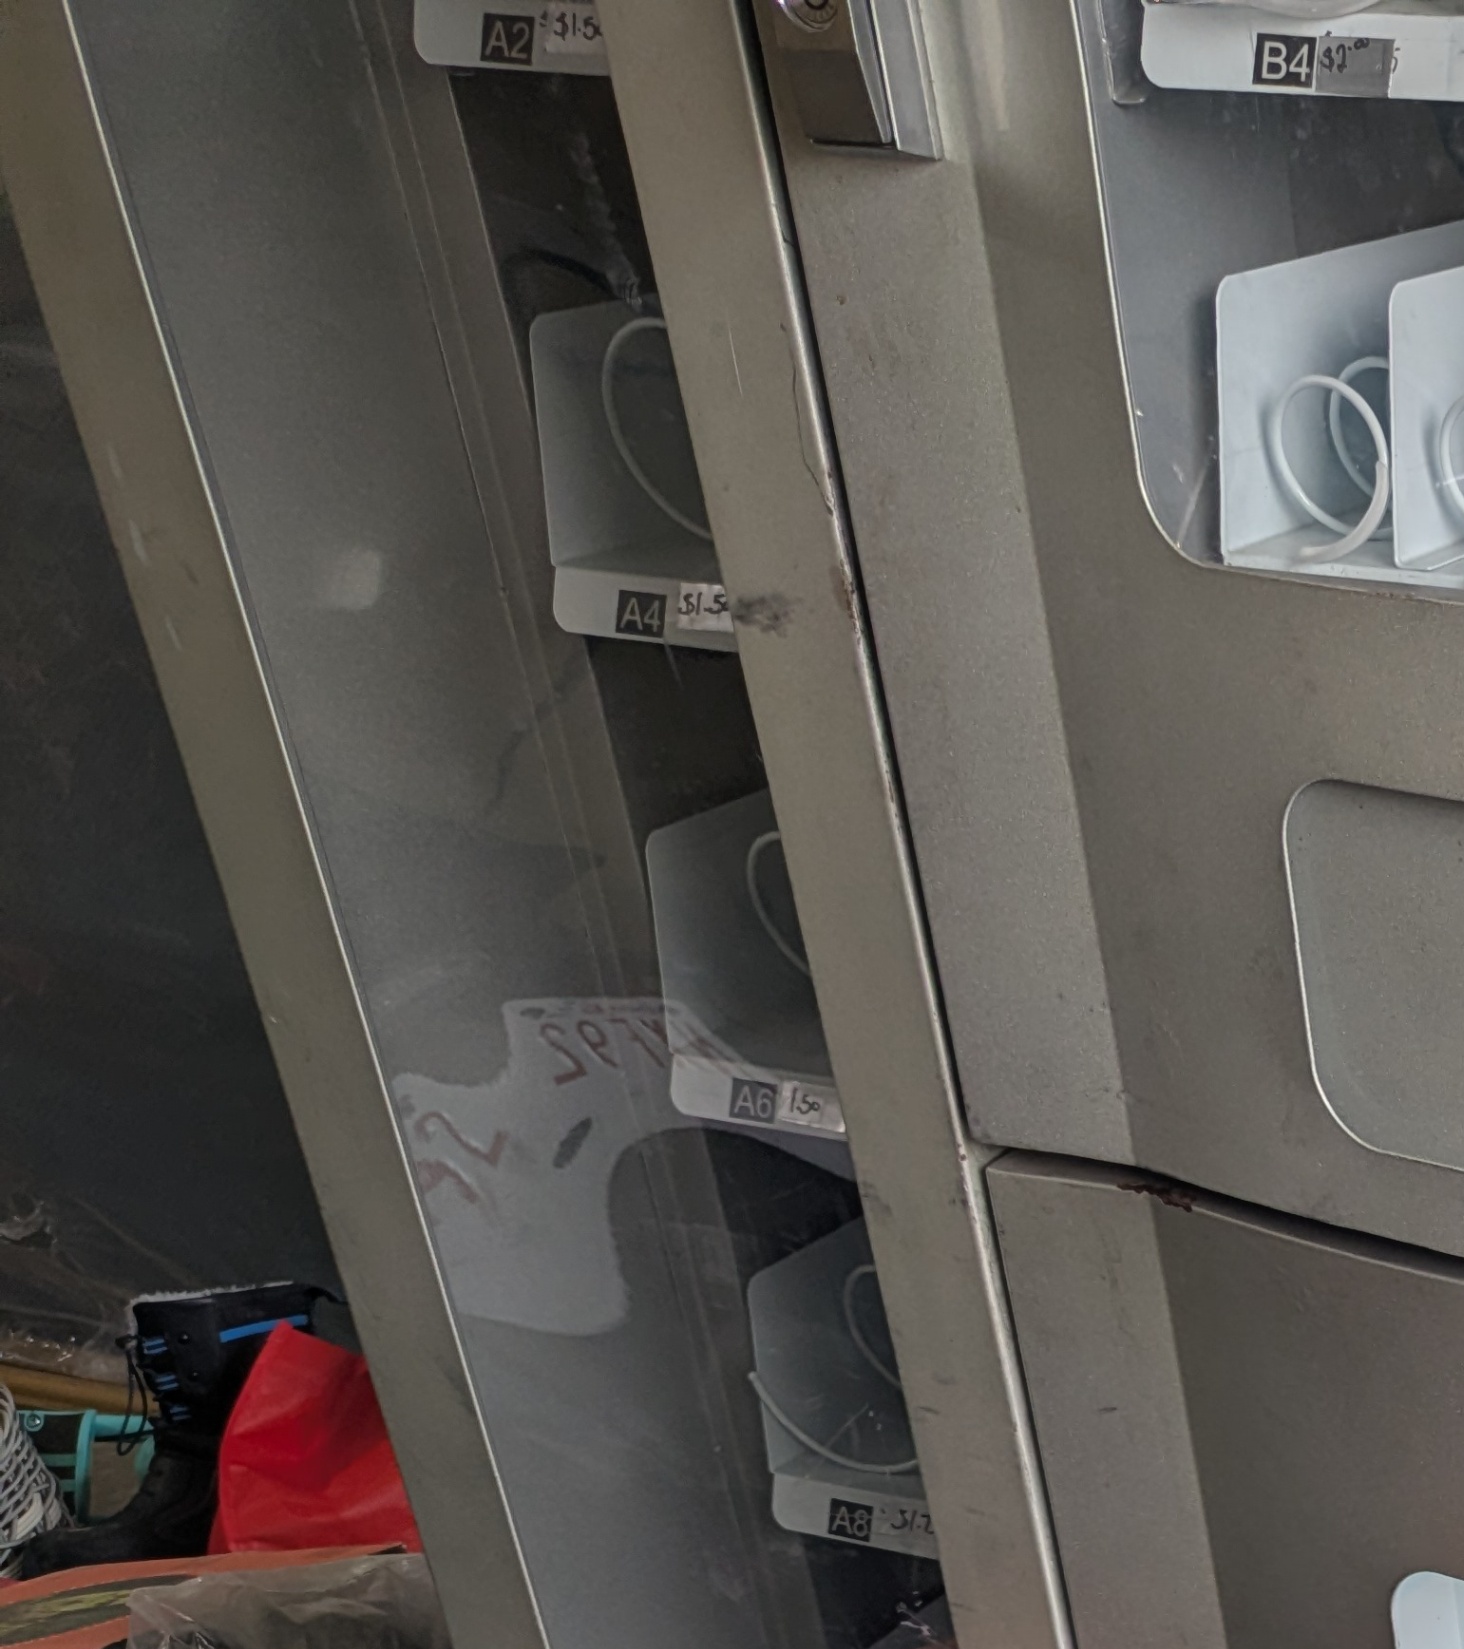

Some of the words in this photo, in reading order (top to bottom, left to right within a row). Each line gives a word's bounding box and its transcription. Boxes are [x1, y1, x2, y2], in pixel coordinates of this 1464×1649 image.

[484, 20, 530, 59] A2
[1261, 40, 1311, 82] B4
[620, 597, 661, 633] A4
[734, 1084, 774, 1119] A6
[831, 1506, 869, 1537] A8
